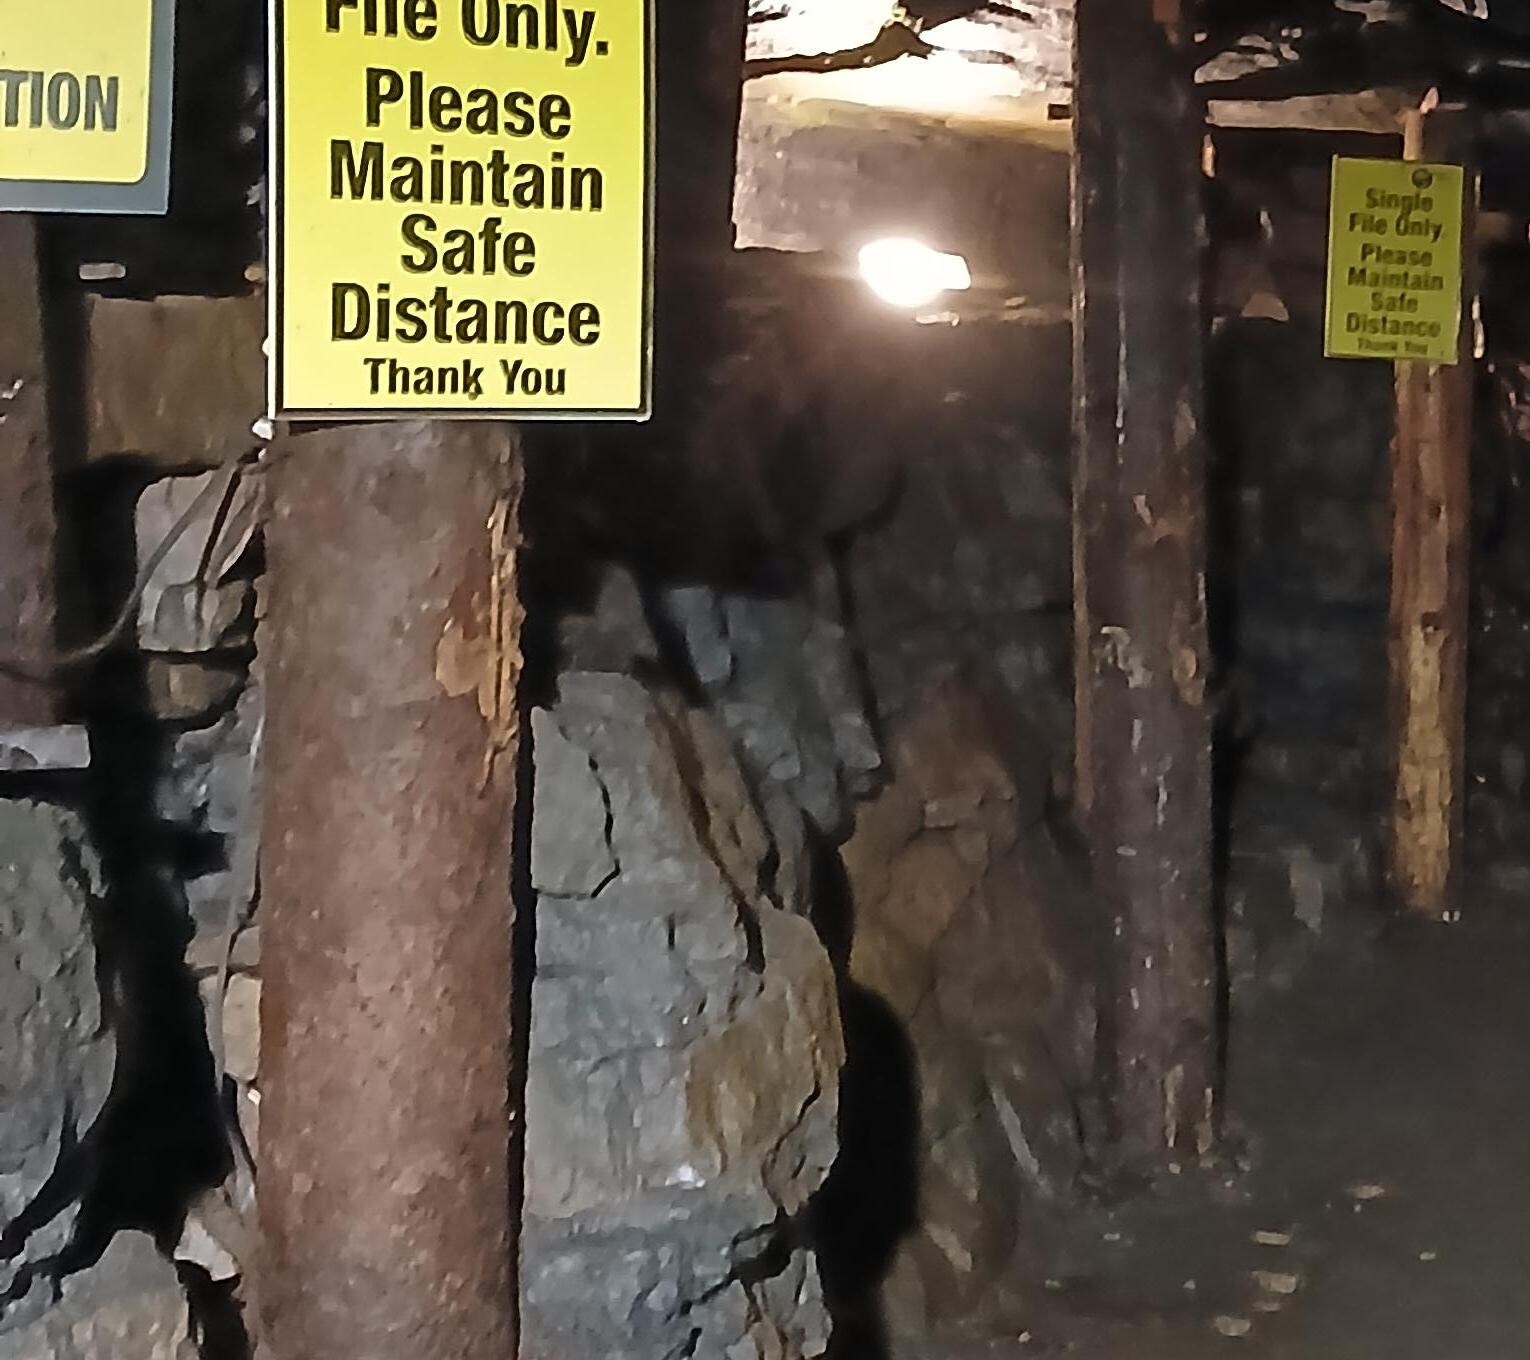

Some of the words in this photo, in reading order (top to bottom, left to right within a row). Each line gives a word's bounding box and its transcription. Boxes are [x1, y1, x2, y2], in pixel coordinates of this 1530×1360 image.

[366, 67, 571, 140] Please
[330, 138, 603, 212] Maintain
[400, 213, 536, 278] Safe
[331, 282, 601, 346] Distance
[364, 357, 484, 396] Thank
[499, 358, 567, 396] You
